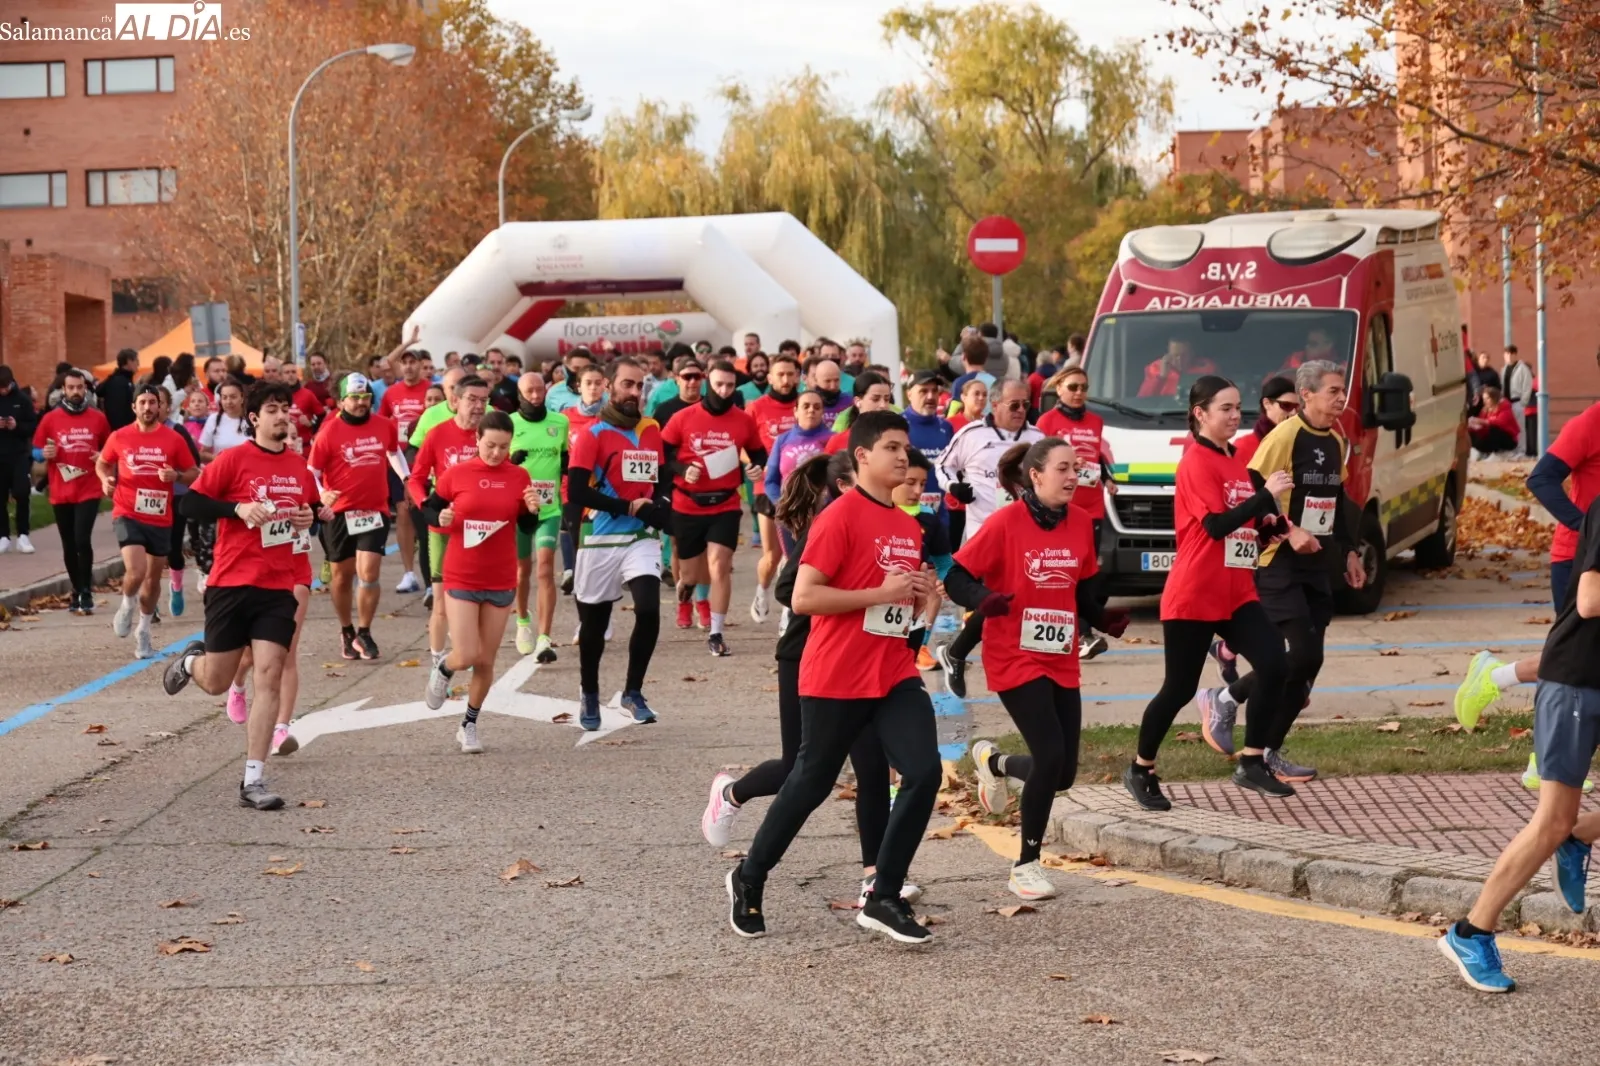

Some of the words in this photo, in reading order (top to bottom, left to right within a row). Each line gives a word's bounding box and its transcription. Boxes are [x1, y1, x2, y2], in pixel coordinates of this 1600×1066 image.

[629, 462, 651, 474] 212
[143, 498, 161, 509] 104
[354, 516, 374, 528] 429
[1319, 511, 1326, 526] 6
[269, 520, 291, 537] 449
[1235, 542, 1255, 559] 262
[884, 606, 903, 625] 66
[1023, 610, 1074, 625] bedunia
[1033, 624, 1066, 643] 206
